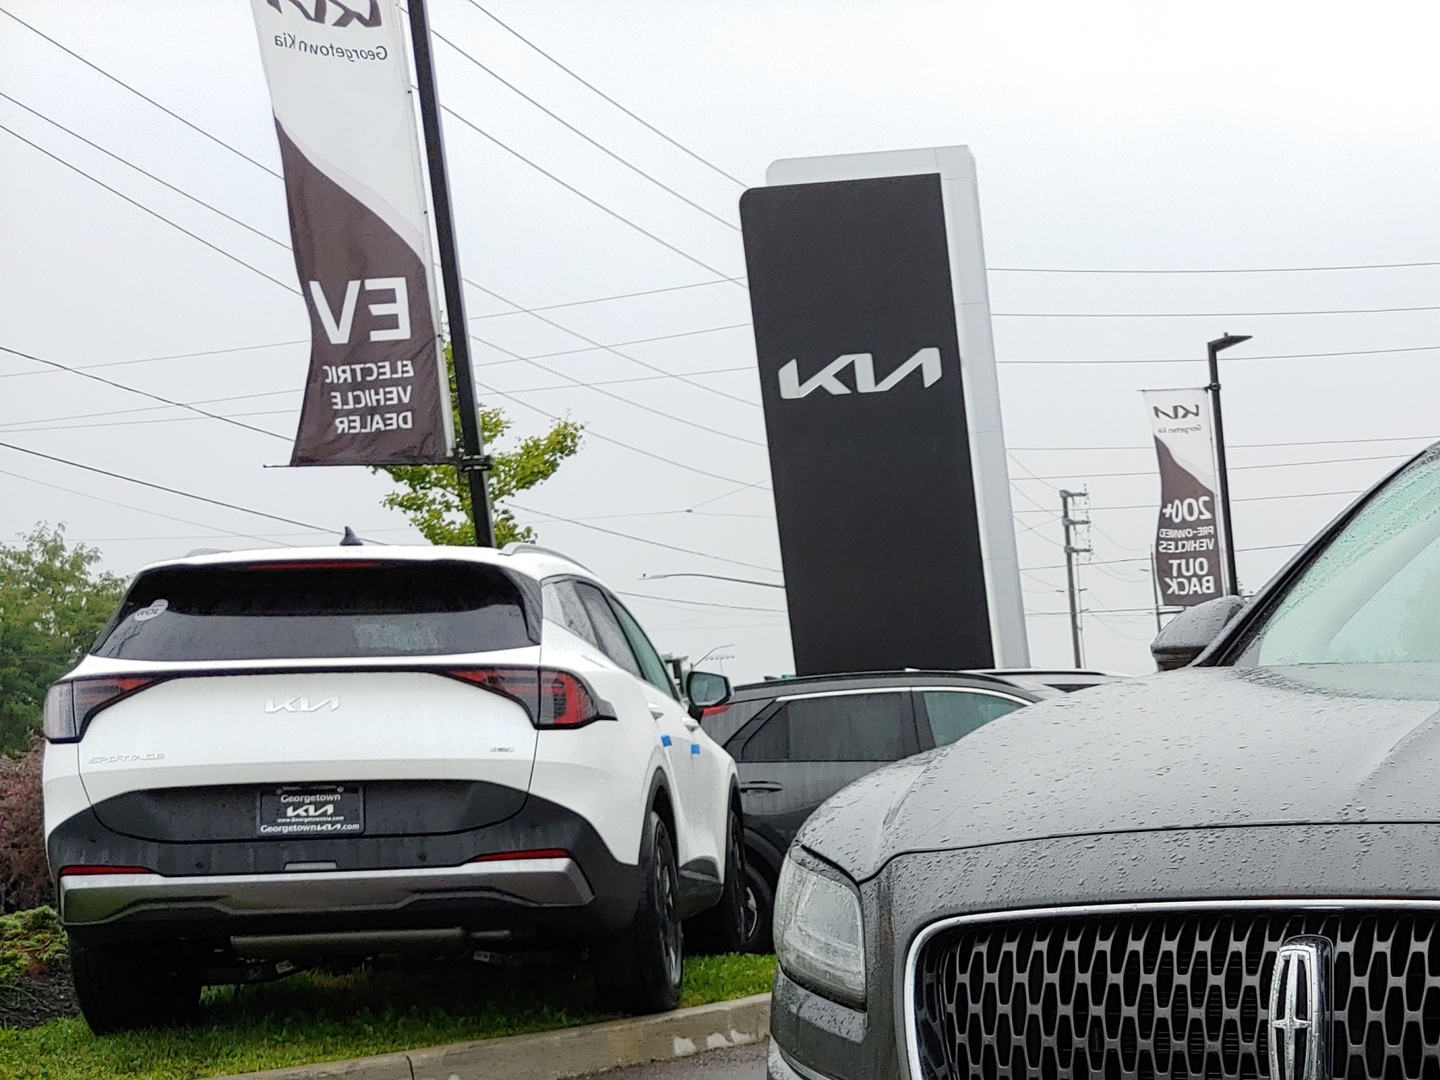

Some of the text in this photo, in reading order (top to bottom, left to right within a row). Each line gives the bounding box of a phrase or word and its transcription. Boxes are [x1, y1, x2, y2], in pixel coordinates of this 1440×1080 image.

[778, 347, 942, 400] KIA
[265, 695, 340, 714] KIA
[88, 753, 166, 765] SPORTAGE
[281, 794, 342, 804] Georgetown
[286, 804, 334, 817] KIA
